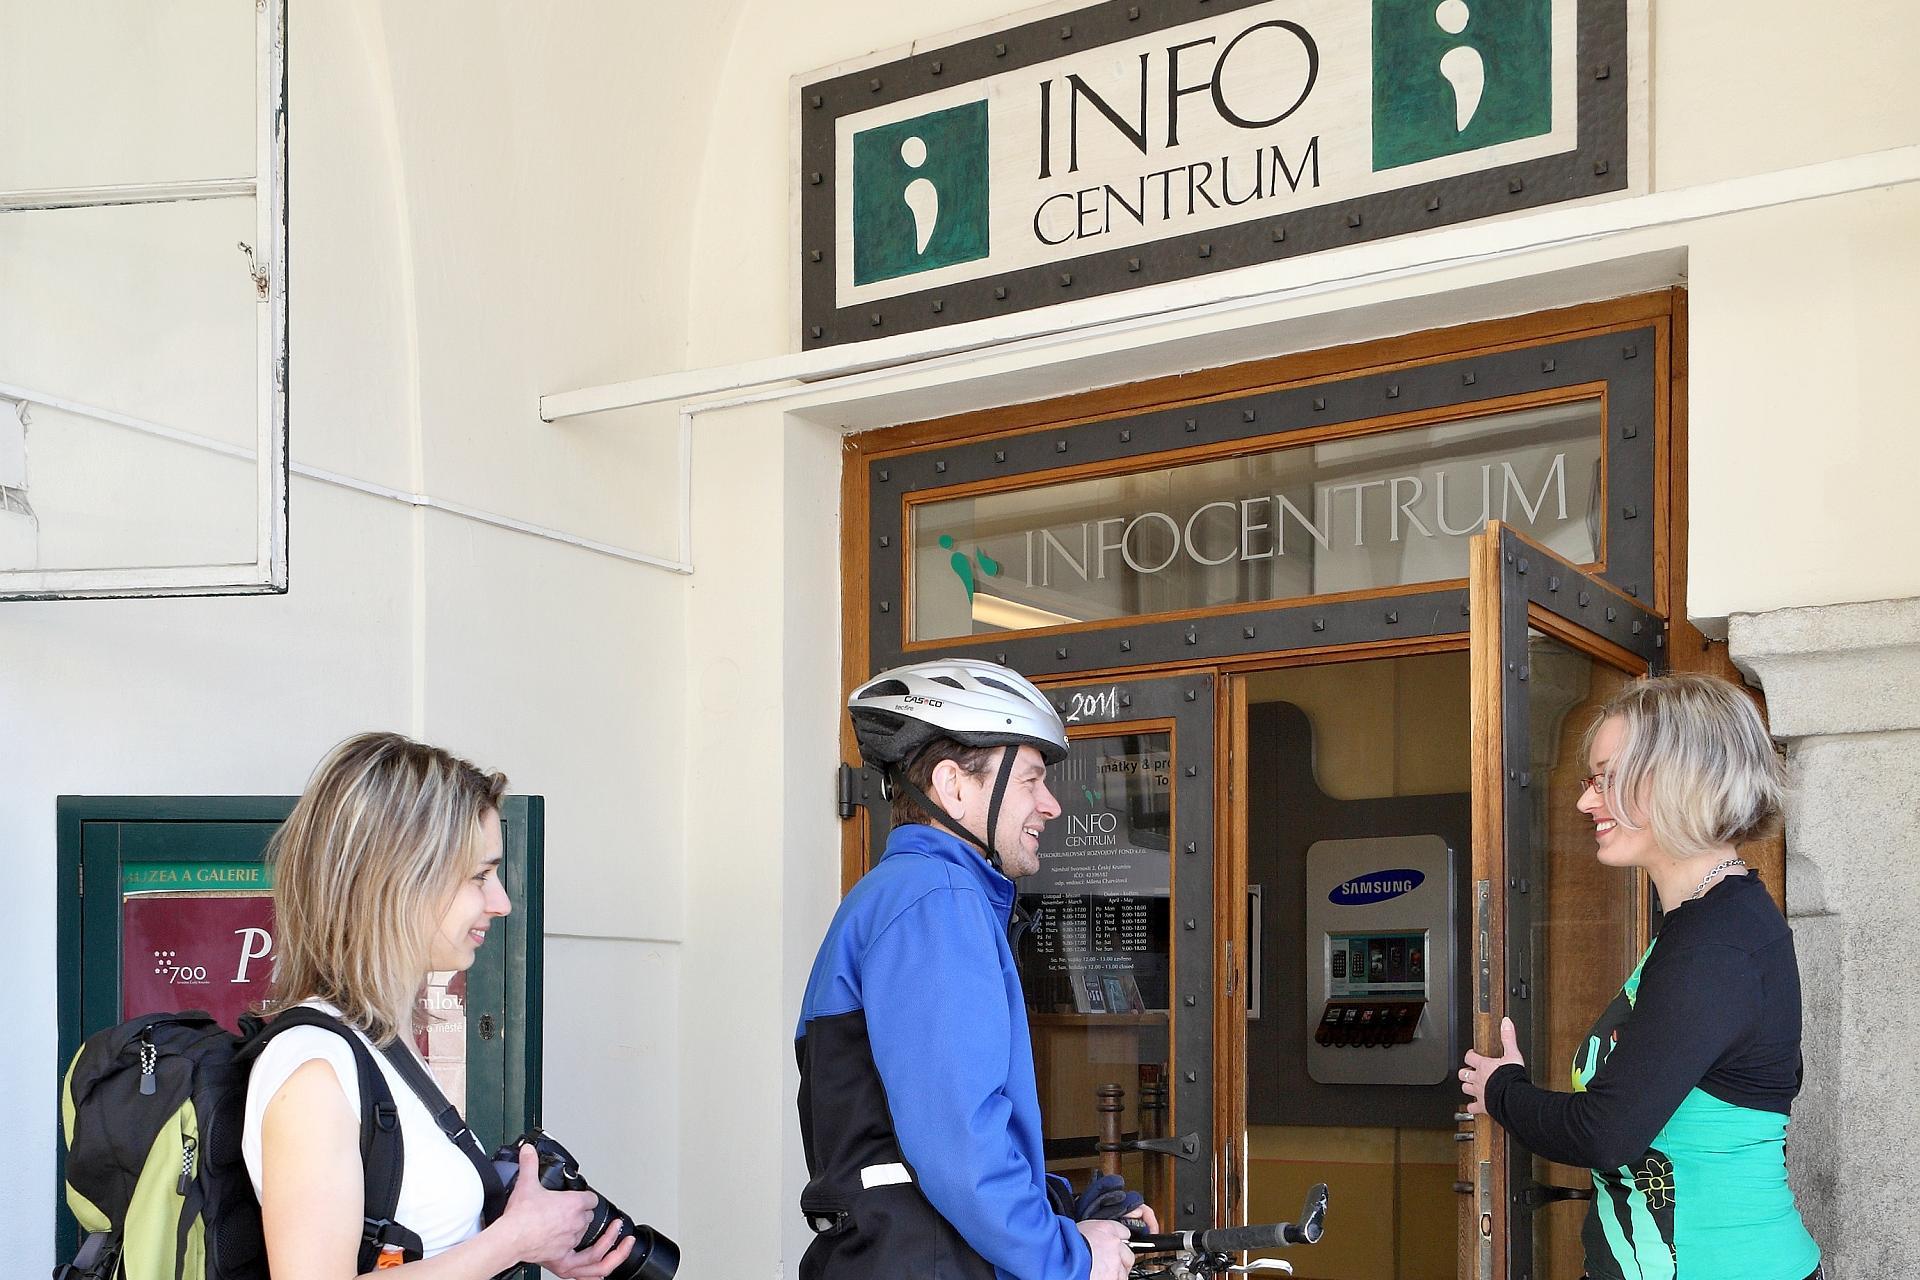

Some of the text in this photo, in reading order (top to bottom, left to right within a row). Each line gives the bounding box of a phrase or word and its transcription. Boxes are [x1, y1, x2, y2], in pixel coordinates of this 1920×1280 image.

[1038, 20, 1319, 179] INFO
[1033, 136, 1320, 245] CENTRUM
[1025, 453, 1568, 588] INFOCENTRUM
[1066, 686, 1115, 722] 2011
[1067, 812, 1117, 834] INFO
[1065, 834, 1116, 847] CENTRUM
[197, 868, 259, 882] GALERIE
[1341, 880, 1412, 895] SAMSUNG
[168, 967, 206, 984] 700
[418, 991, 464, 1010] mlov
